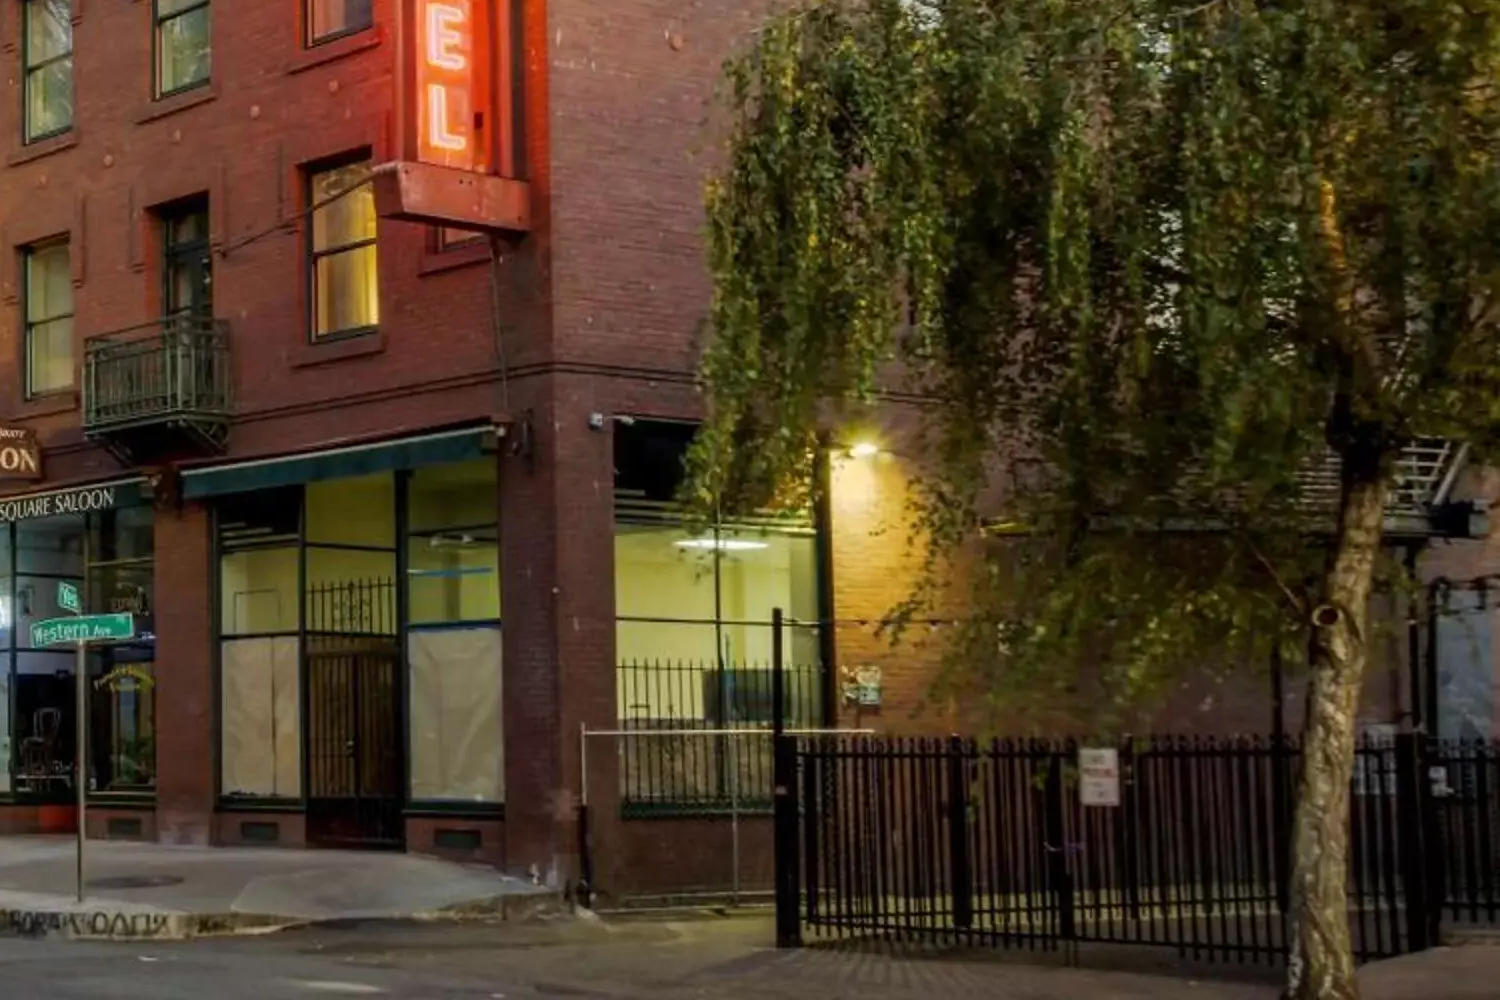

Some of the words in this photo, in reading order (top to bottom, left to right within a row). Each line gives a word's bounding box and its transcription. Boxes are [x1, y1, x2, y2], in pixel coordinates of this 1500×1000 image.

[0, 497, 52, 522] SQUARE
[55, 487, 117, 513] SALOON
[33, 623, 89, 645] Western
[93, 623, 113, 637] Ave
